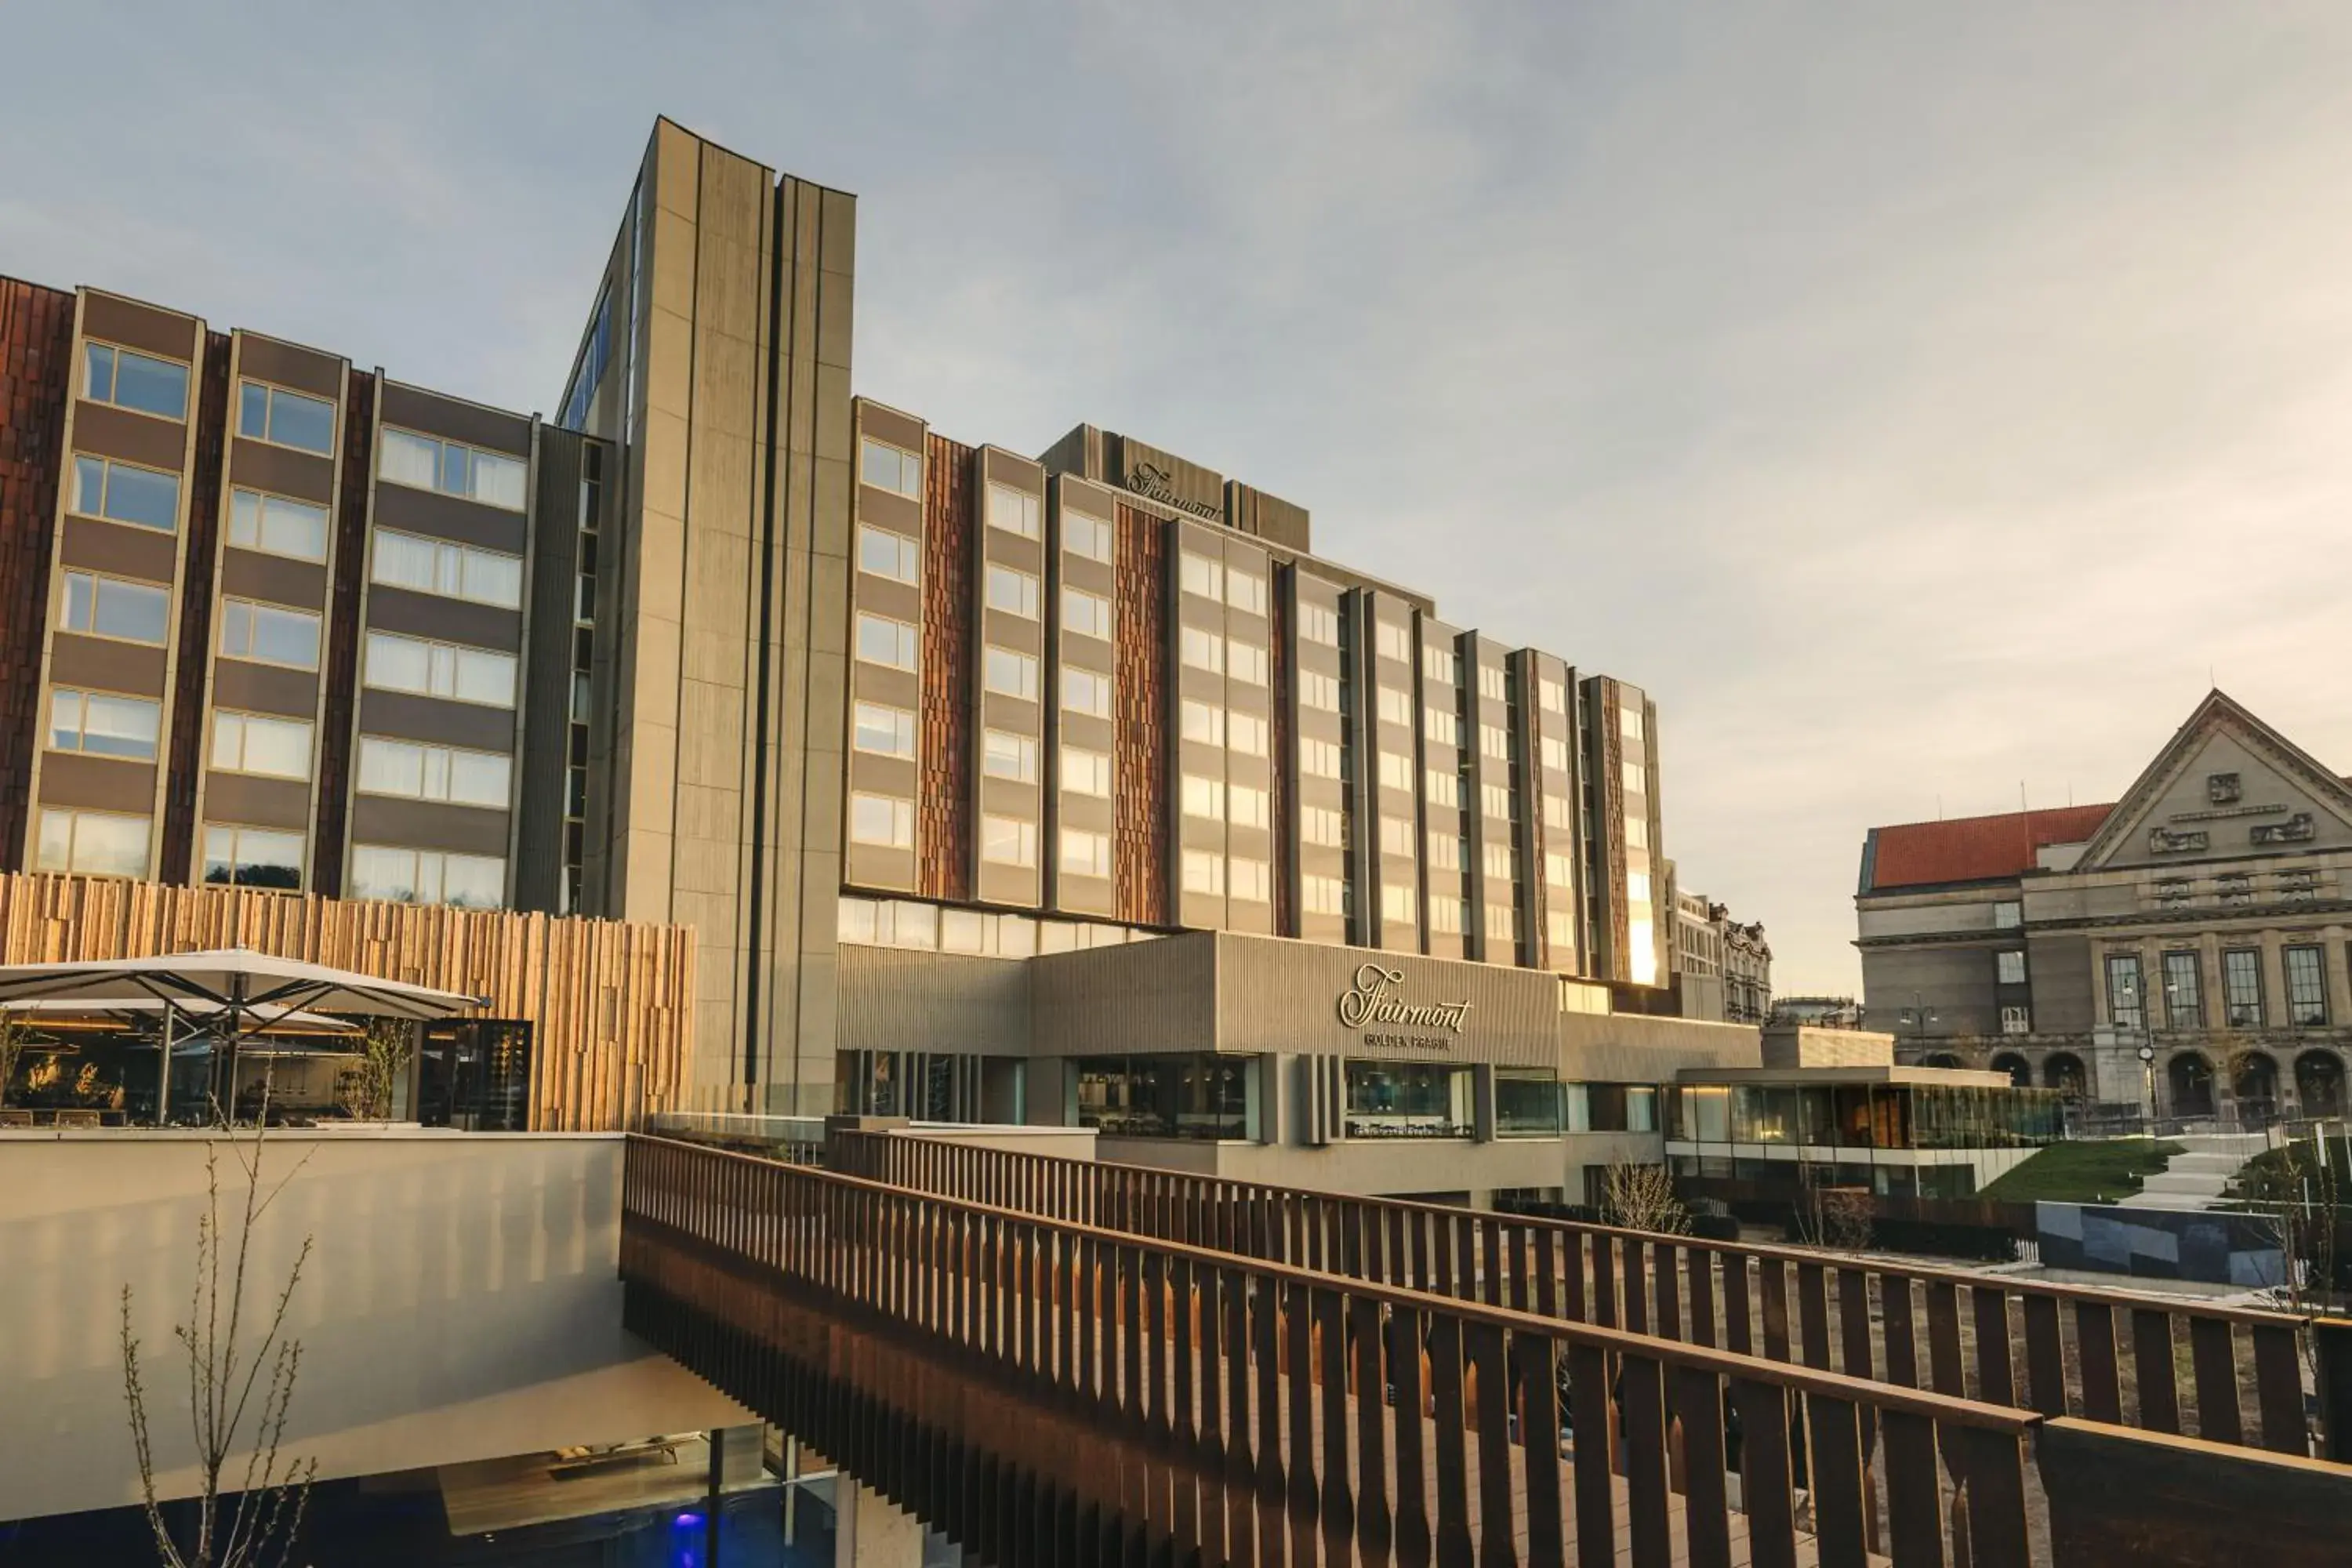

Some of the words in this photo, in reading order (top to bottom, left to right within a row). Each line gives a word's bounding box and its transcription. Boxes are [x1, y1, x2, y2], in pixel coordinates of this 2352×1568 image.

[1126, 462, 1222, 520] Fairmont
[1340, 963, 1474, 1033] Fairmont
[1364, 1033, 1408, 1047] GOLDEN
[1410, 1035, 1452, 1051] PRAGUE
